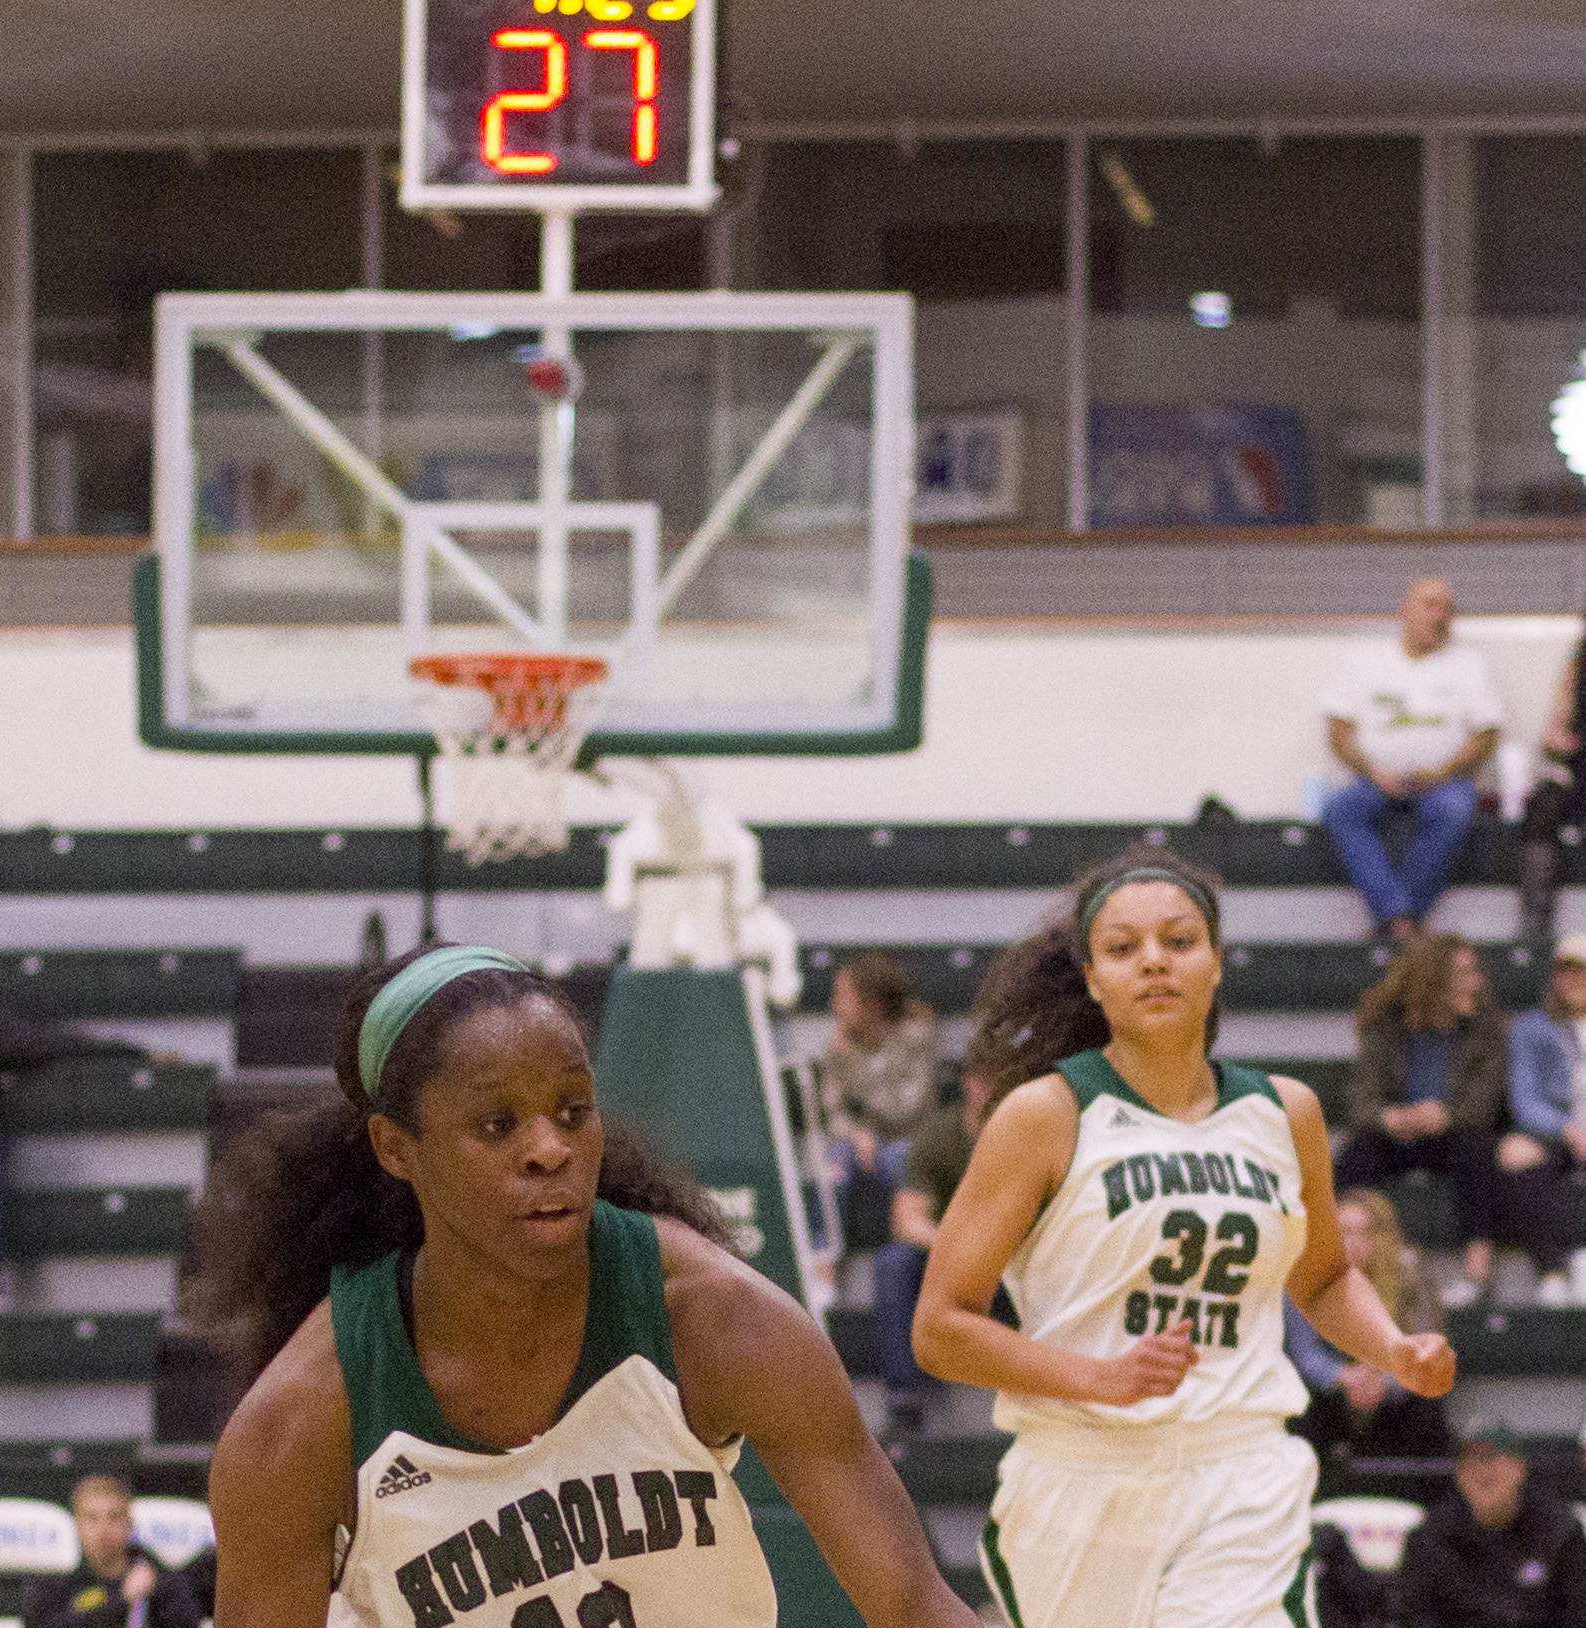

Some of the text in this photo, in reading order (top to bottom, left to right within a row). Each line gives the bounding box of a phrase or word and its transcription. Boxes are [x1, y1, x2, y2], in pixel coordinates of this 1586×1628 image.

[480, 28, 660, 175] 27
[1148, 1209, 1260, 1296] 32
[375, 1470, 432, 1499] adidas
